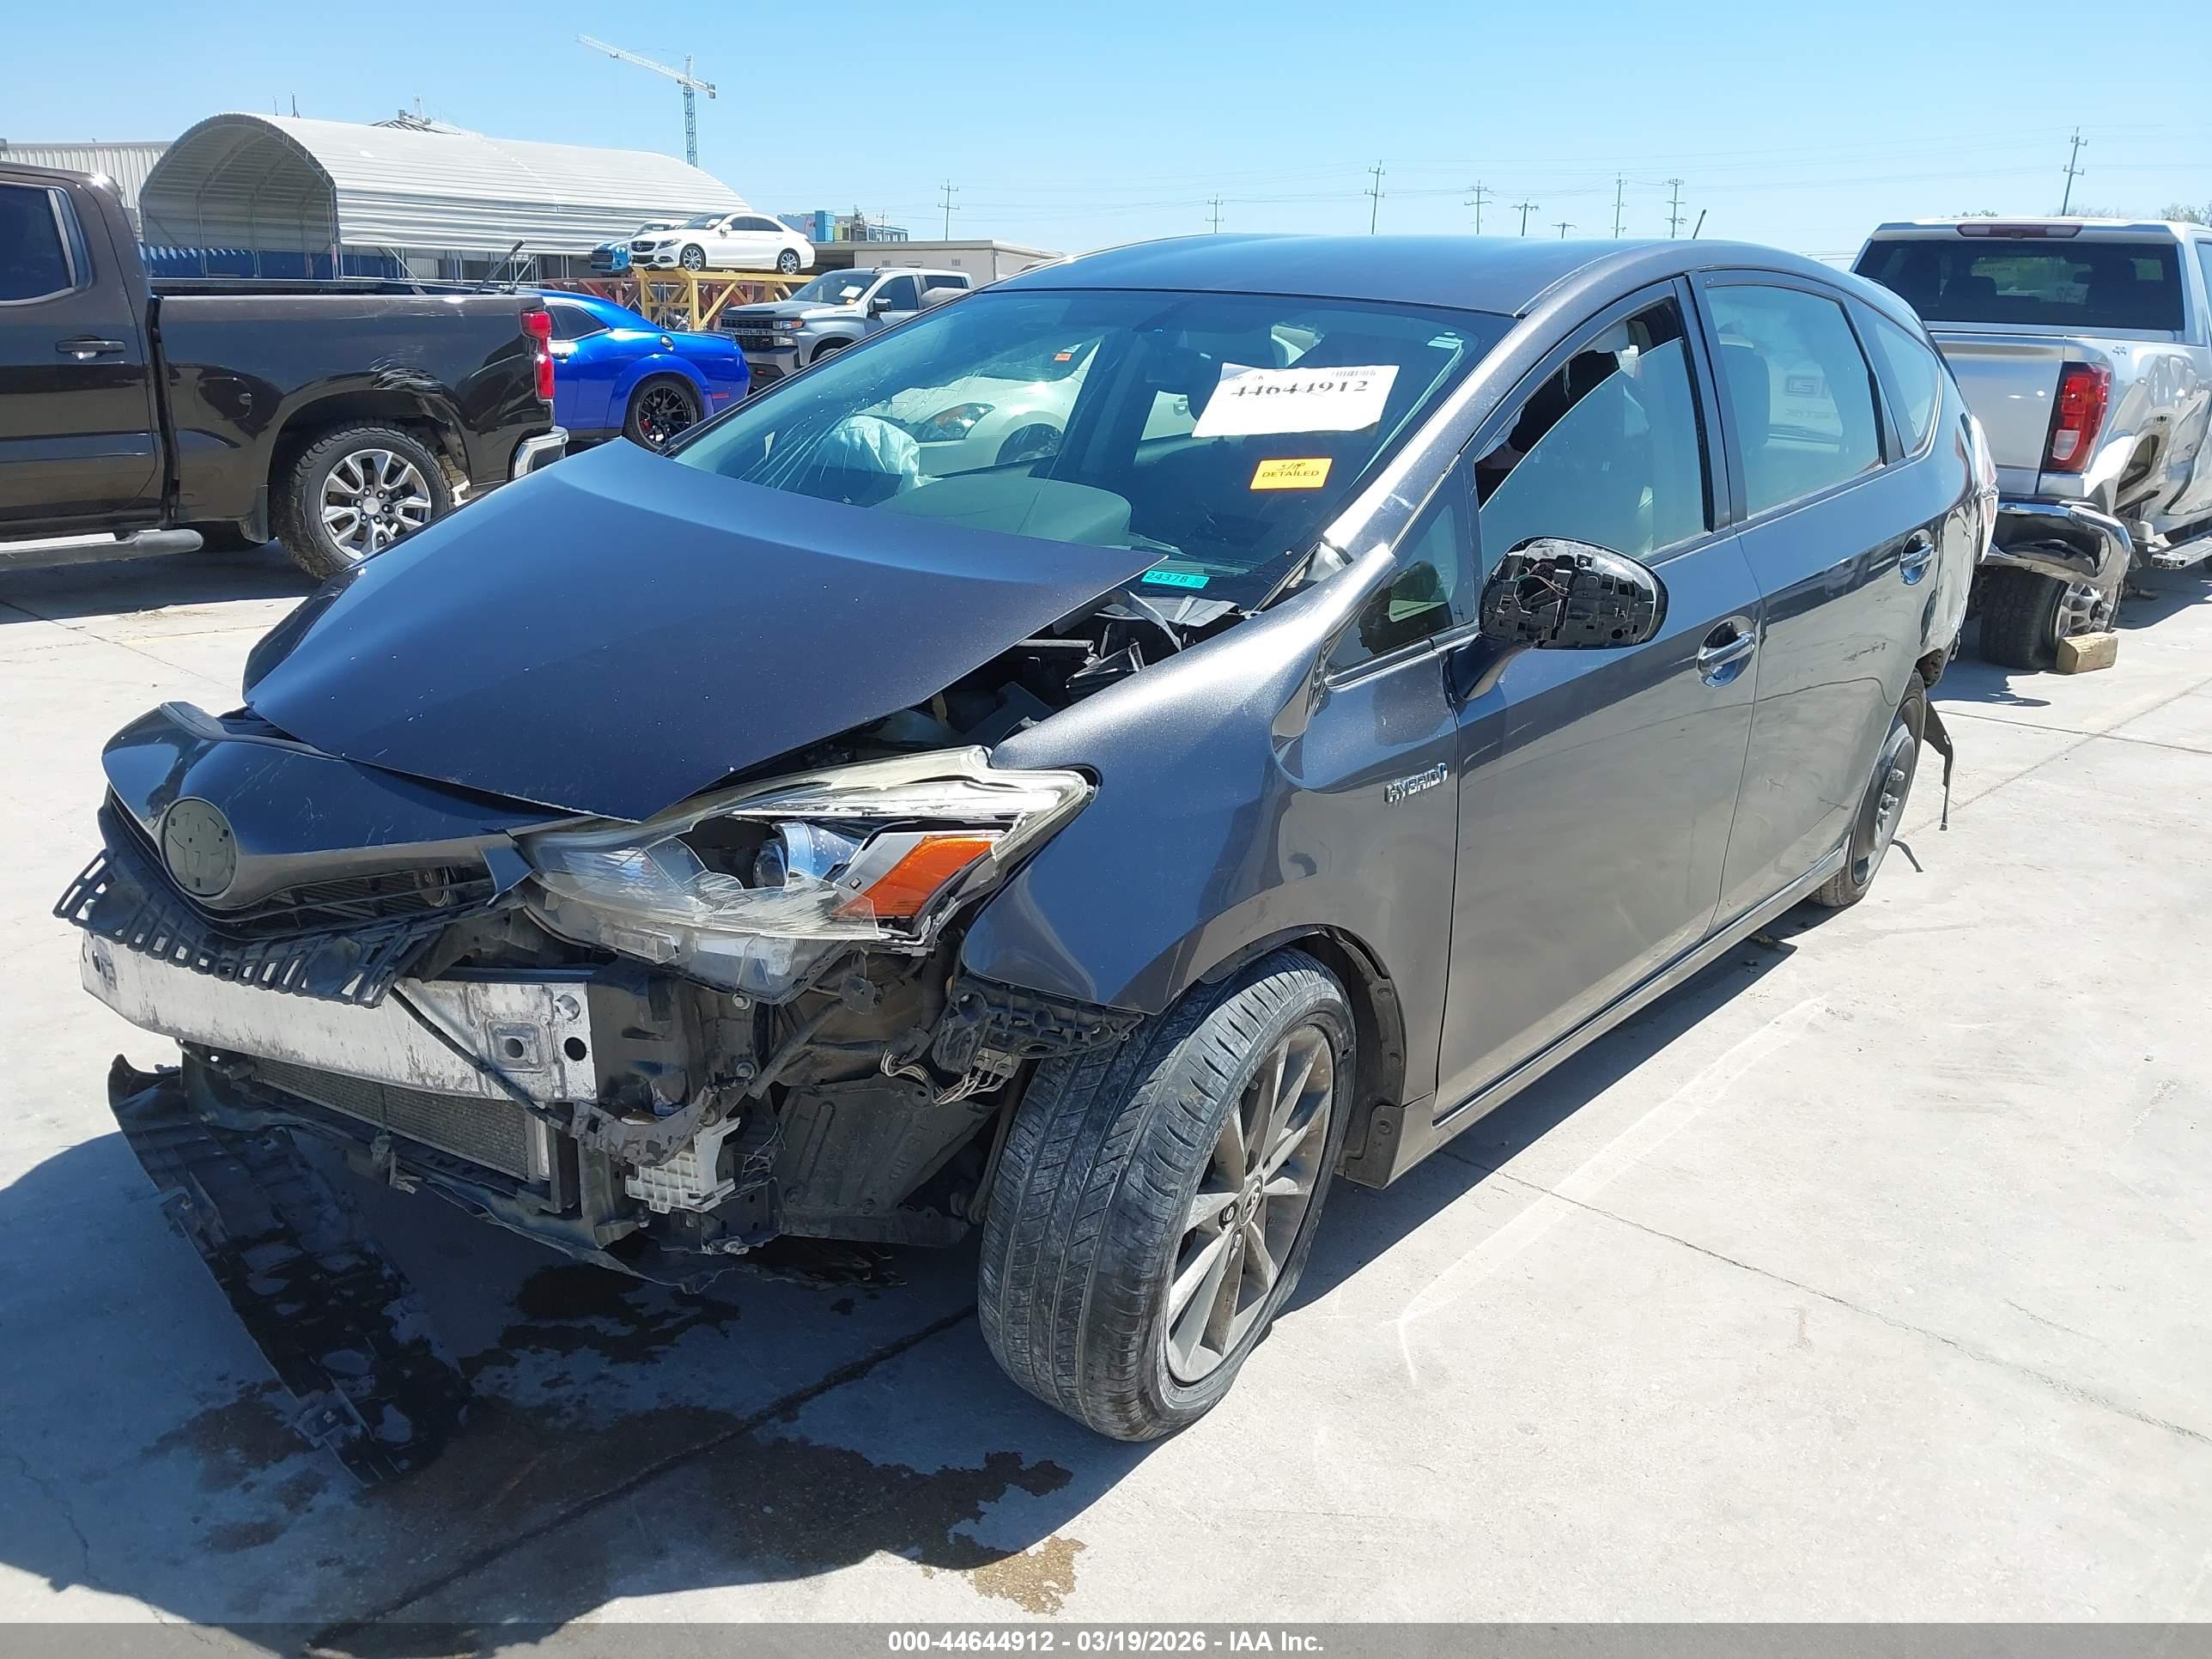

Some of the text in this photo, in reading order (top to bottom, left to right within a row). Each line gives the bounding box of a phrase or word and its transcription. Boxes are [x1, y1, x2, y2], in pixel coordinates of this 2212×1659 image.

[1261, 469, 1320, 478] DETAILED
[1146, 571, 1189, 584] 24378
[1385, 769, 1441, 803] HYBRID
